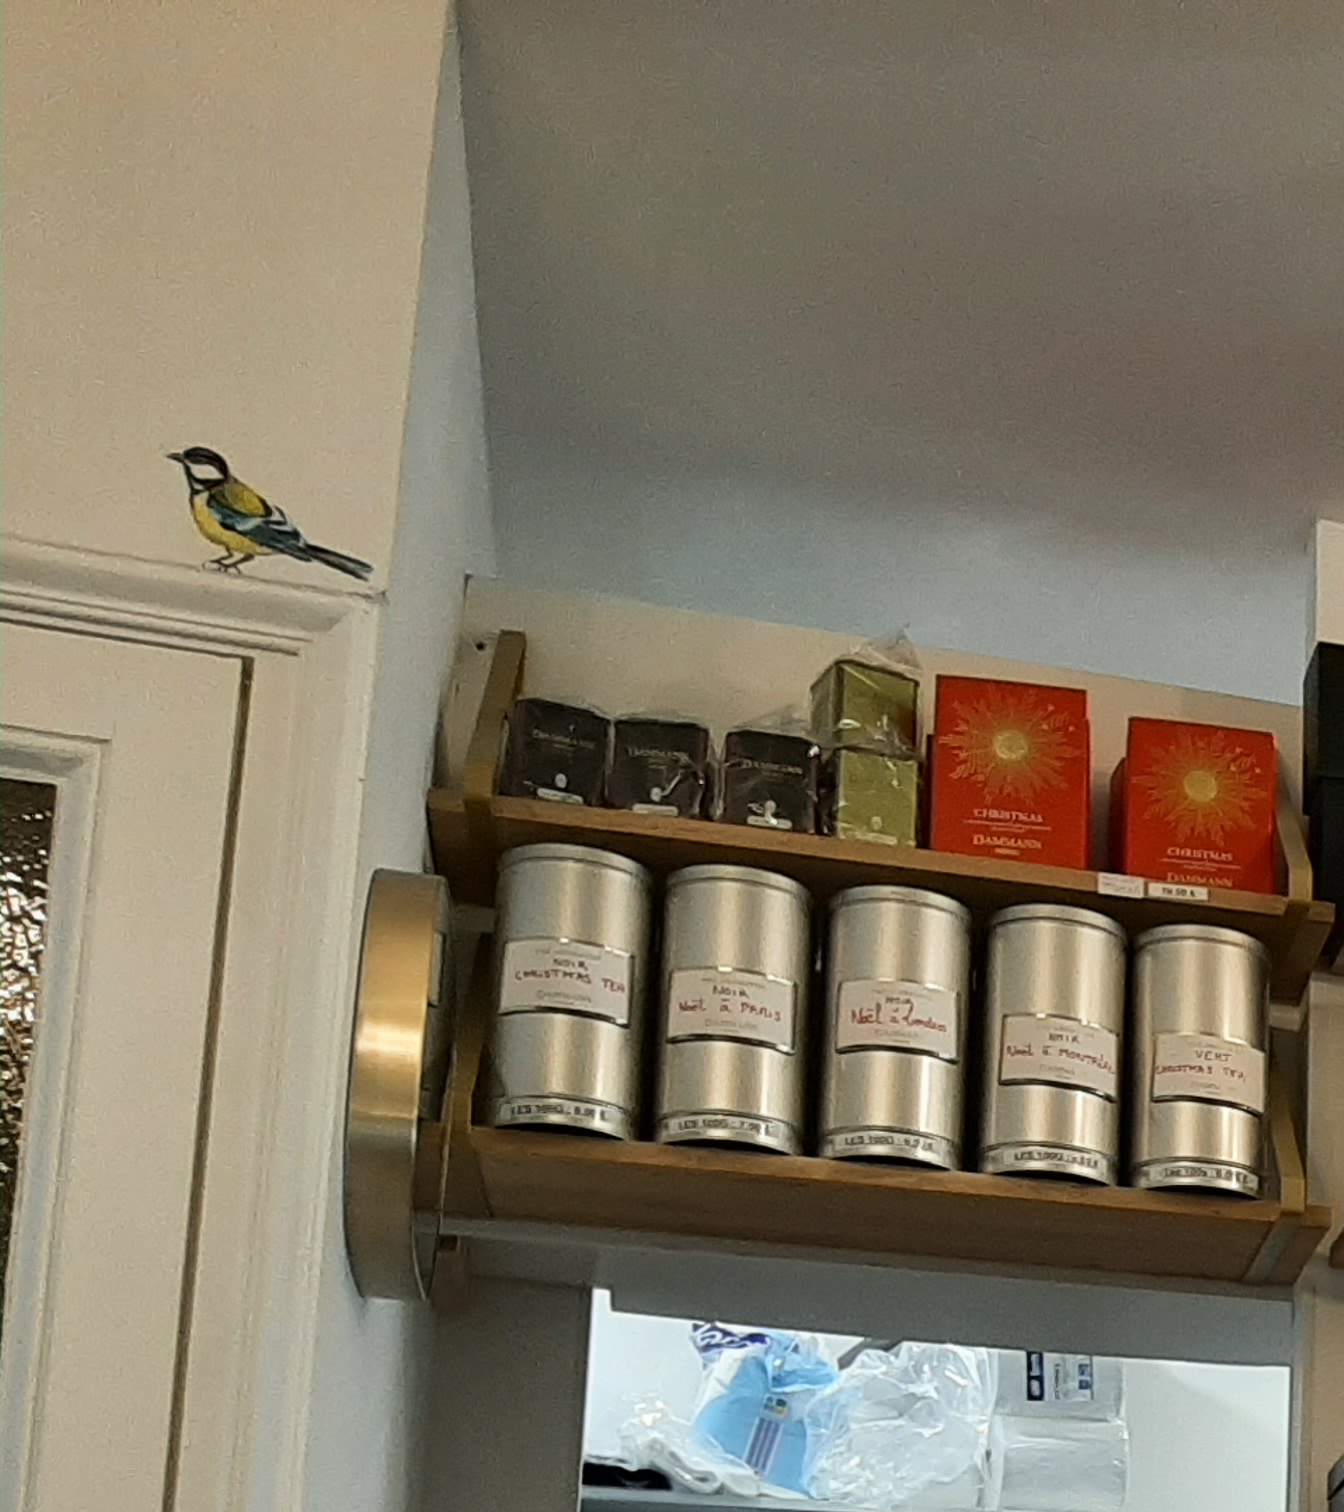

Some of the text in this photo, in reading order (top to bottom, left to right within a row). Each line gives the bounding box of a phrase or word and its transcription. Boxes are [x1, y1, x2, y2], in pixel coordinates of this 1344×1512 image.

[973, 807, 1045, 823] CHRISTMAS
[973, 832, 1042, 849] DAMMANN
[1166, 846, 1234, 862] CHRISTMAS
[514, 968, 626, 994] CHRISTMAS TEA
[712, 985, 748, 999] NOIR
[739, 1001, 782, 1021] PARIS
